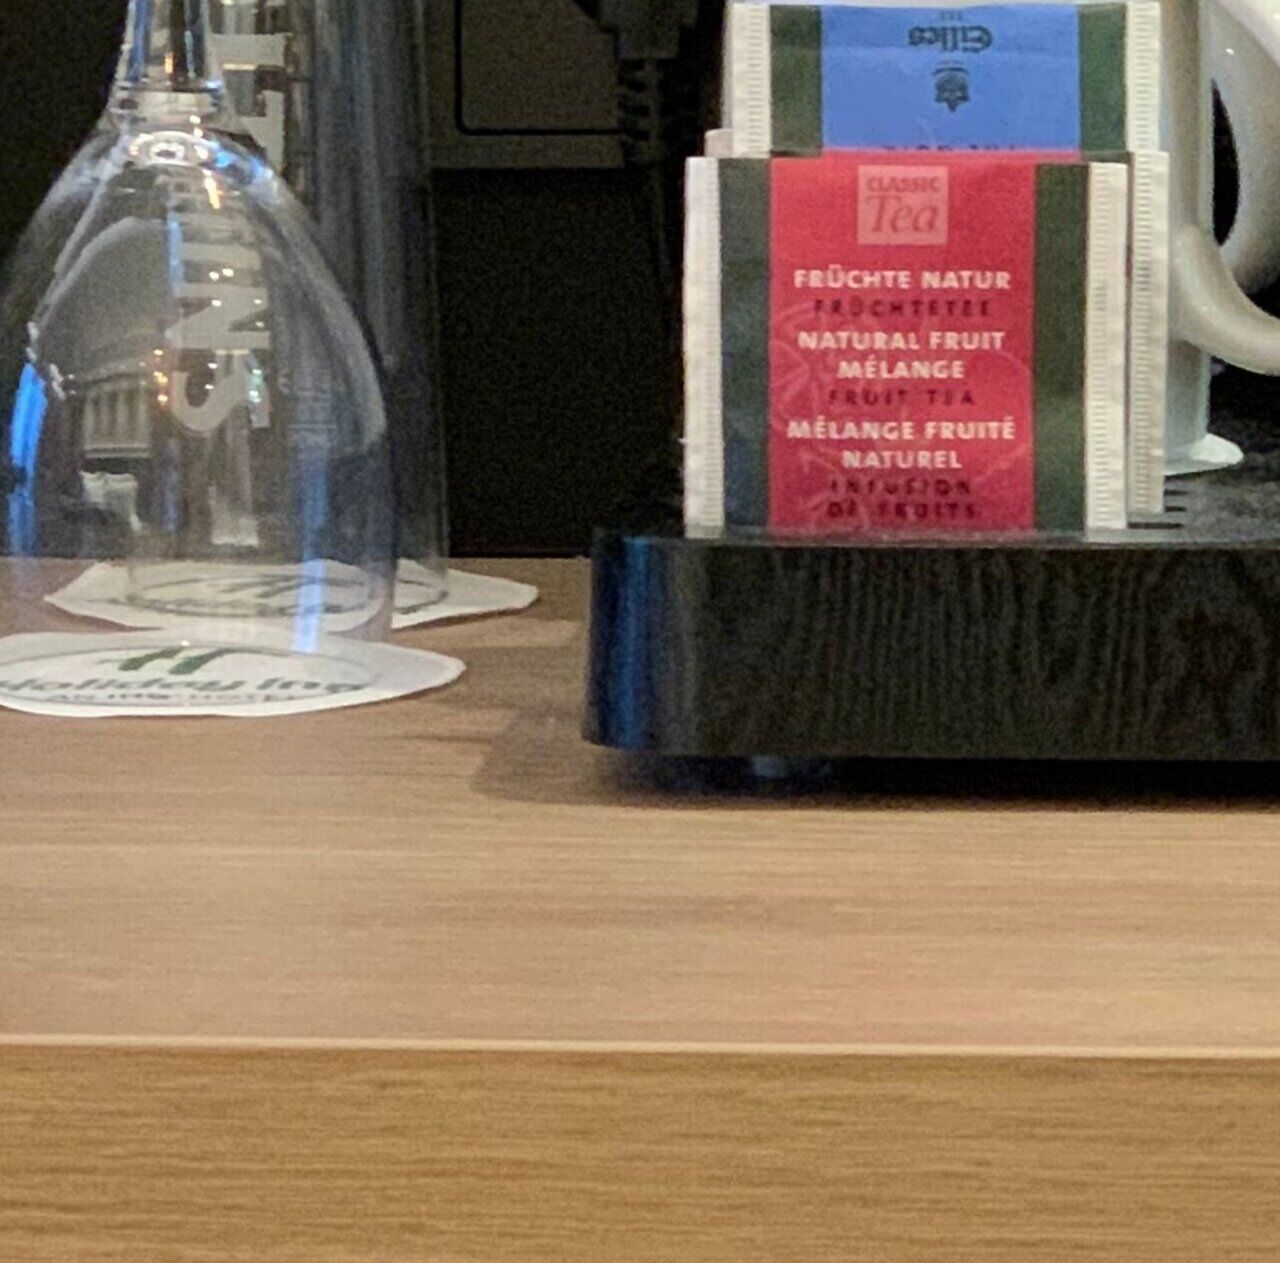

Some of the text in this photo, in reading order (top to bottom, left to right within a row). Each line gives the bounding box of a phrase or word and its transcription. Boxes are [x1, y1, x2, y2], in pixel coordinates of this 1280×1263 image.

[866, 176, 939, 192] CLASSIC
[865, 195, 939, 233] Tea
[793, 264, 1012, 290] FRÜCHTE NATUR
[814, 297, 990, 317] FRÜCHTETEE
[797, 331, 1006, 350] NATURAL FRUIT
[836, 355, 966, 379] MÉLANGE
[828, 389, 975, 406] FRUIT TEA
[786, 415, 1016, 440] MÉLANGE FRUITÉ
[840, 450, 963, 470] NATUREL
[830, 478, 970, 495] INFUSION
